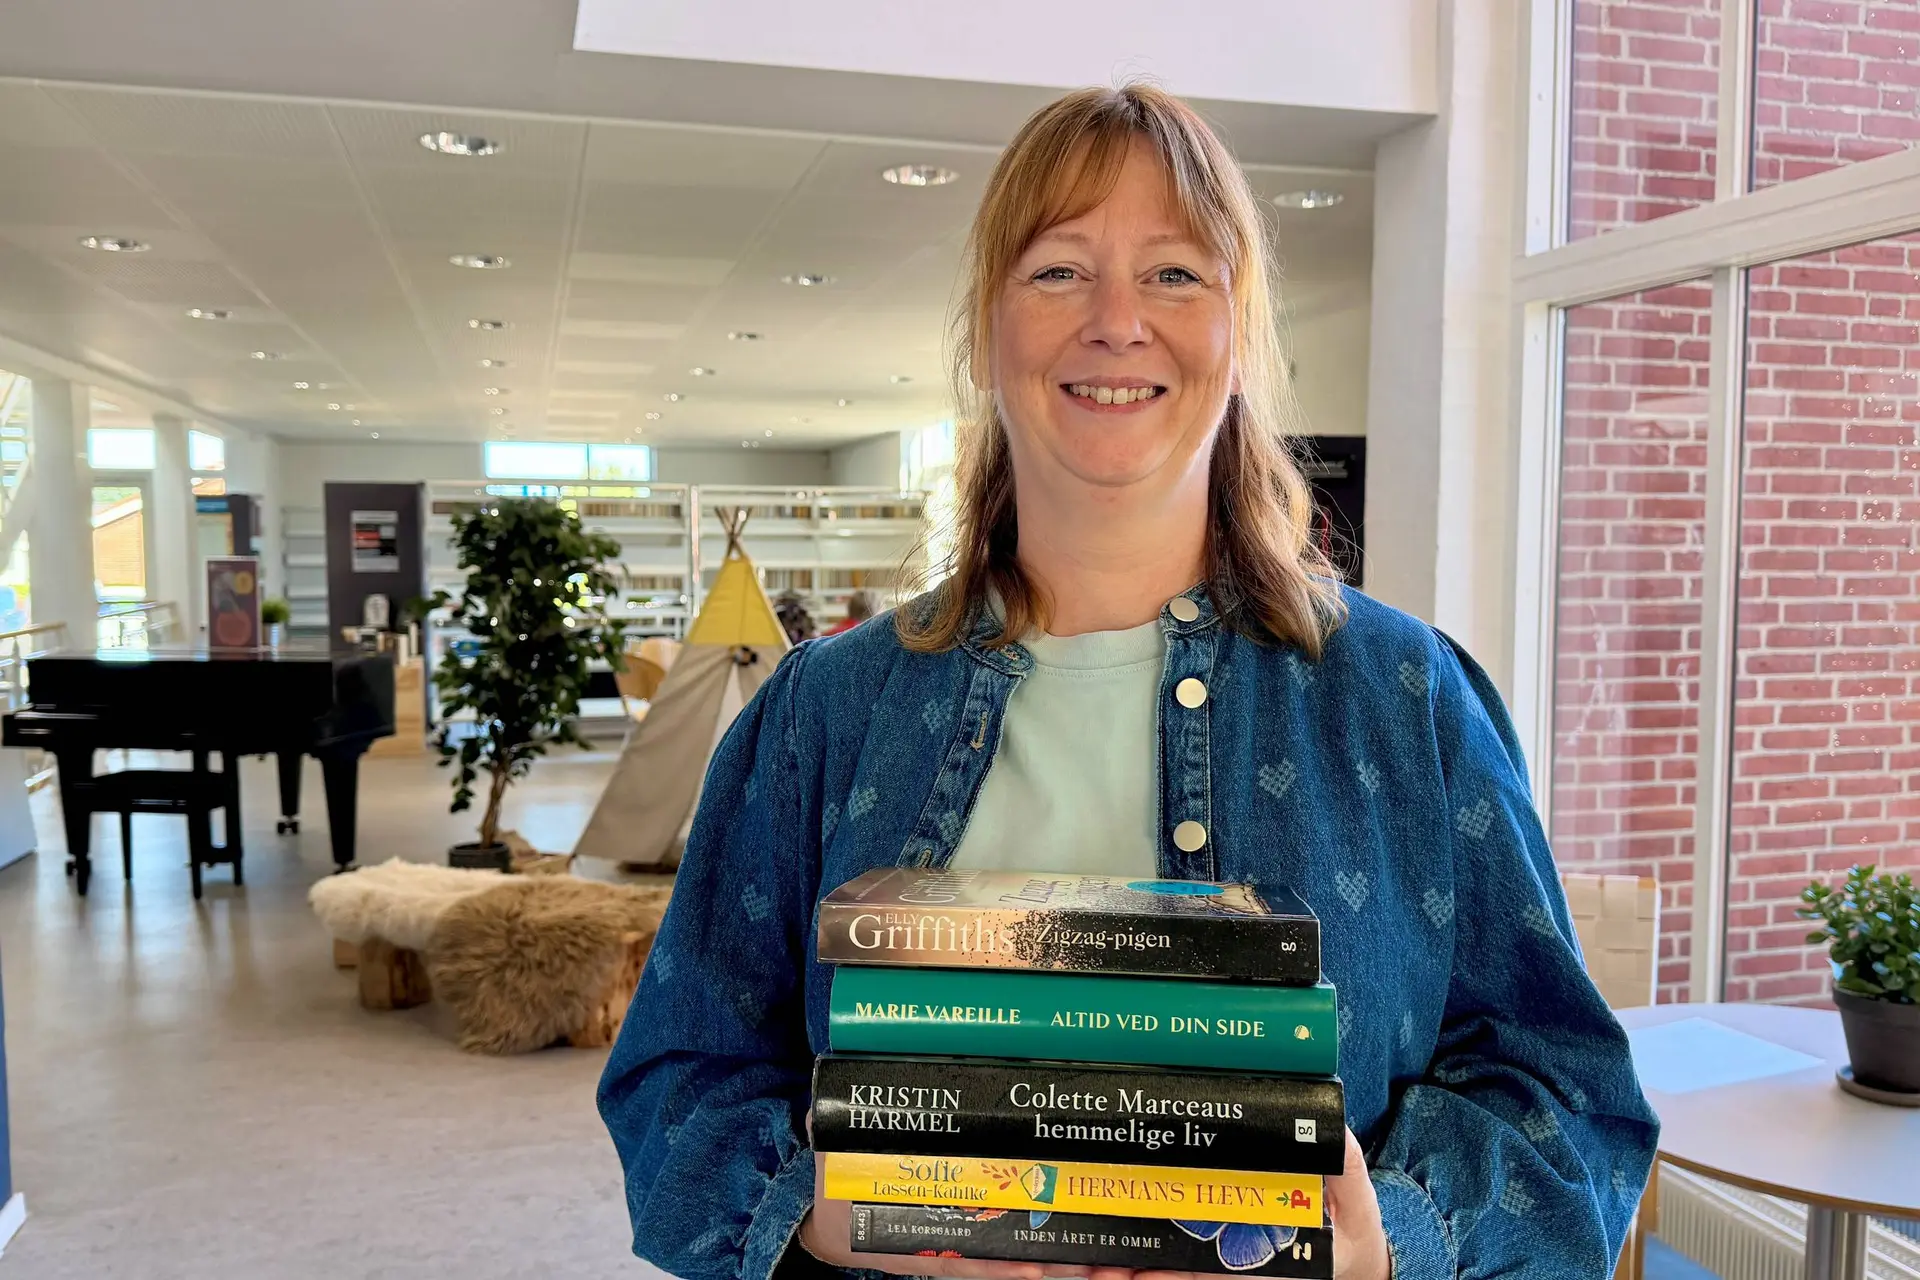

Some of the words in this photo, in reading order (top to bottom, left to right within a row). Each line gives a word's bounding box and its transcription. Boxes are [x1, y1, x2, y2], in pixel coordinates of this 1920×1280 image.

[885, 913, 920, 924] ELLY
[849, 914, 1015, 953] Griffiths
[1036, 923, 1172, 950] Zigzag-pigen
[855, 1002, 920, 1020] MARIE
[925, 1005, 1021, 1024] VAREILLE
[1050, 1011, 1110, 1029] ALTID
[1116, 1013, 1159, 1032] VED
[1170, 1016, 1210, 1034] DIN
[1216, 1019, 1266, 1038] SIDE
[849, 1084, 962, 1110] KRISTIN
[1009, 1083, 1108, 1111] Colette
[1117, 1088, 1243, 1120] Marceaus
[849, 1107, 961, 1133] HARMEL
[1034, 1114, 1175, 1150] hemmelige
[1183, 1122, 1217, 1148] liv
[898, 1158, 964, 1183] Sofie
[1067, 1176, 1185, 1203] HERMANS
[1196, 1183, 1266, 1207] HÆVN
[857, 1211, 867, 1241] 58.443
[888, 1224, 908, 1234] LEA
[911, 1225, 972, 1237] KORSGAARD
[1014, 1229, 1056, 1242] INDEN
[1061, 1229, 1095, 1245] ÅRET
[1100, 1235, 1116, 1246] ER
[1121, 1236, 1161, 1249] OMME
